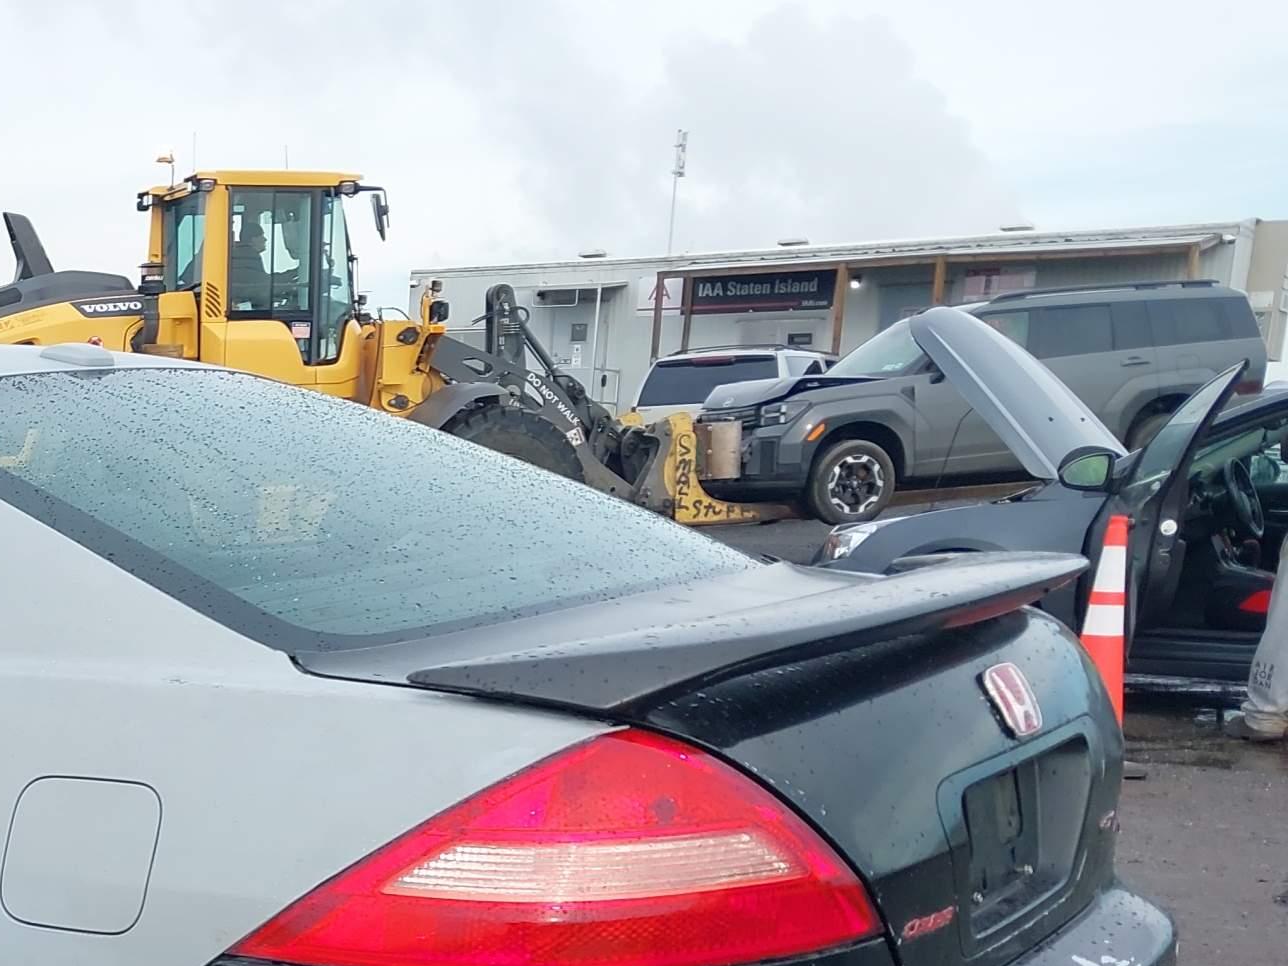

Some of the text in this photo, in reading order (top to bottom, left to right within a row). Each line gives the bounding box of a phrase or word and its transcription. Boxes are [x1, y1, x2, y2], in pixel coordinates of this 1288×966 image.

[698, 277, 818, 297] IAA Staten Island
[80, 301, 142, 313] VOLVO
[526, 372, 542, 387] DO
[539, 384, 560, 404] NOT
[556, 401, 581, 426] WALK
